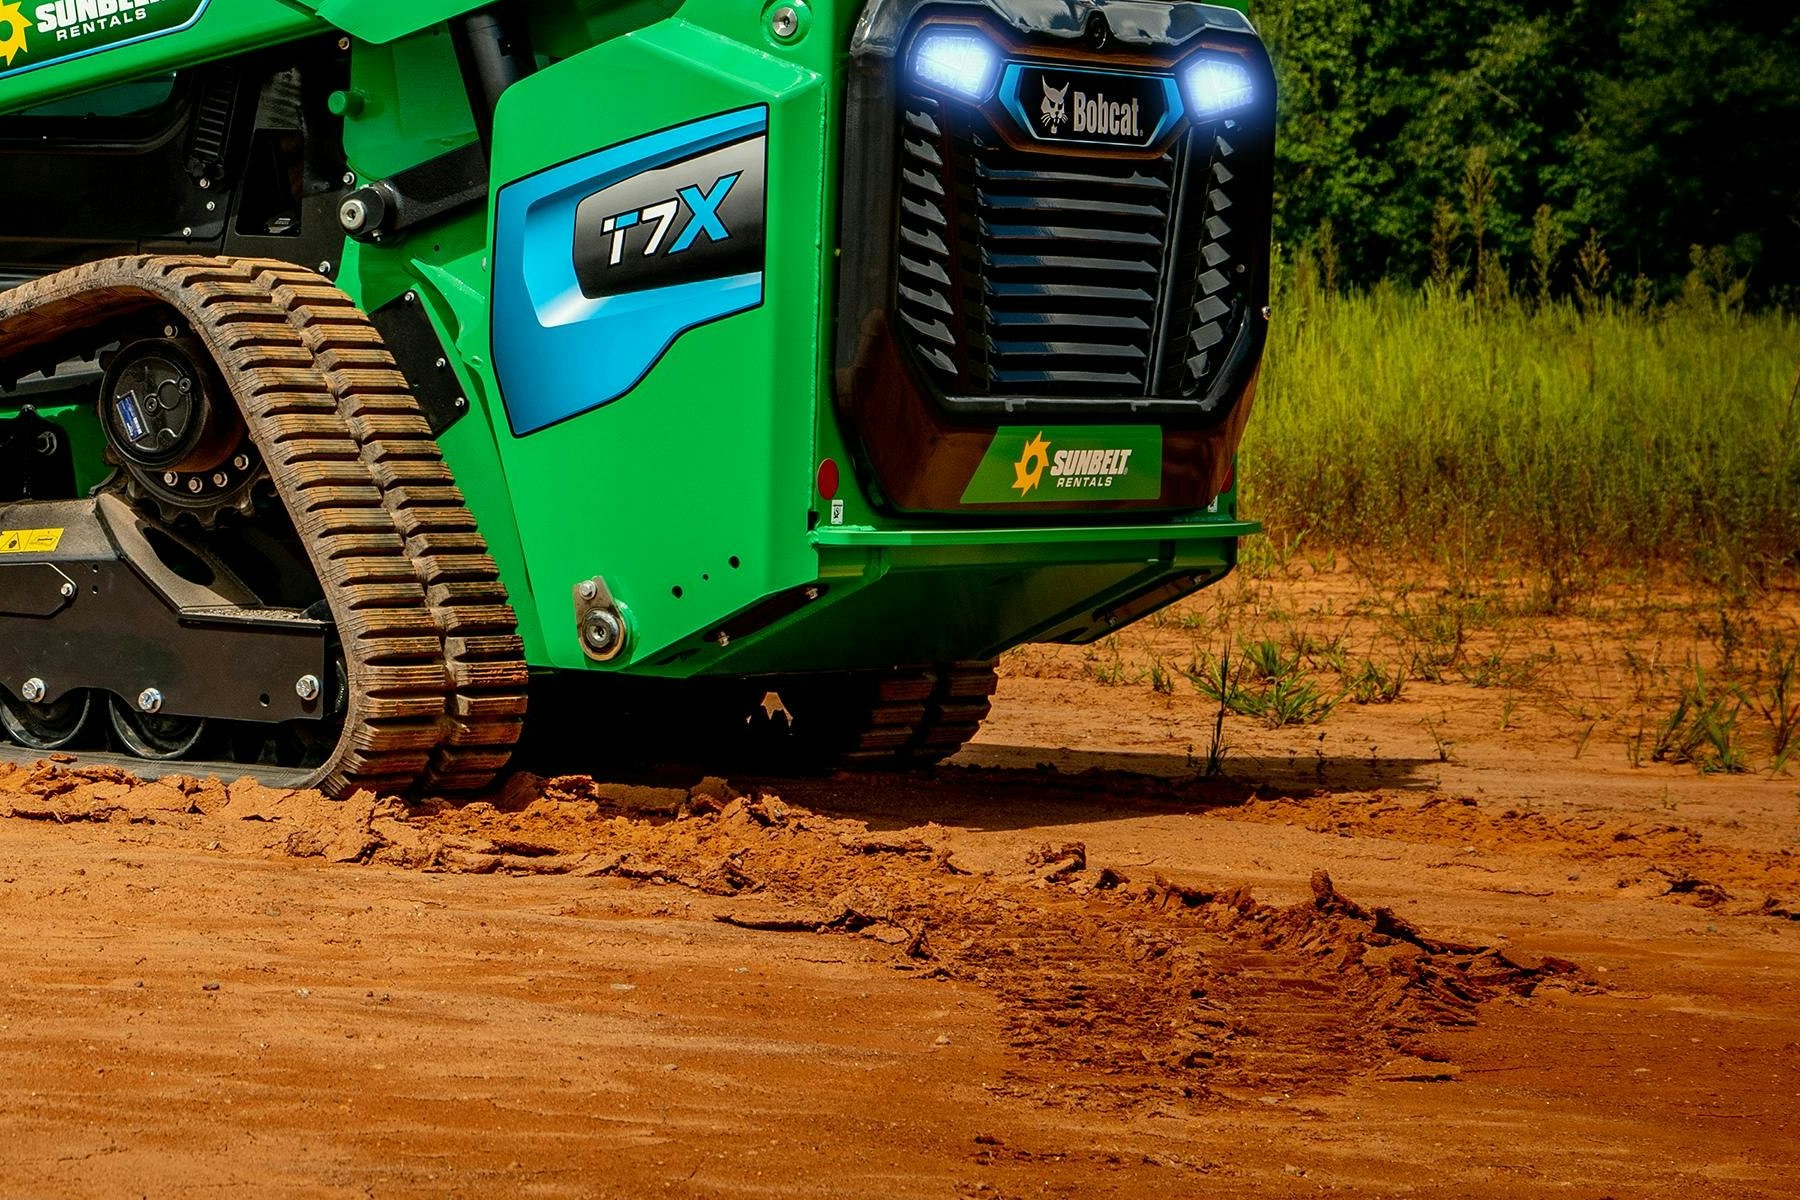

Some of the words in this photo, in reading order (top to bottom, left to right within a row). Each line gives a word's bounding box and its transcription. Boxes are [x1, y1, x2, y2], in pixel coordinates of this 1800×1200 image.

[56, 8, 147, 41] RENTALS
[1073, 91, 1139, 137] Bobcat
[601, 171, 743, 267] T7X
[1050, 449, 1132, 476] SUNBELT
[1056, 476, 1113, 488] RENTALS
